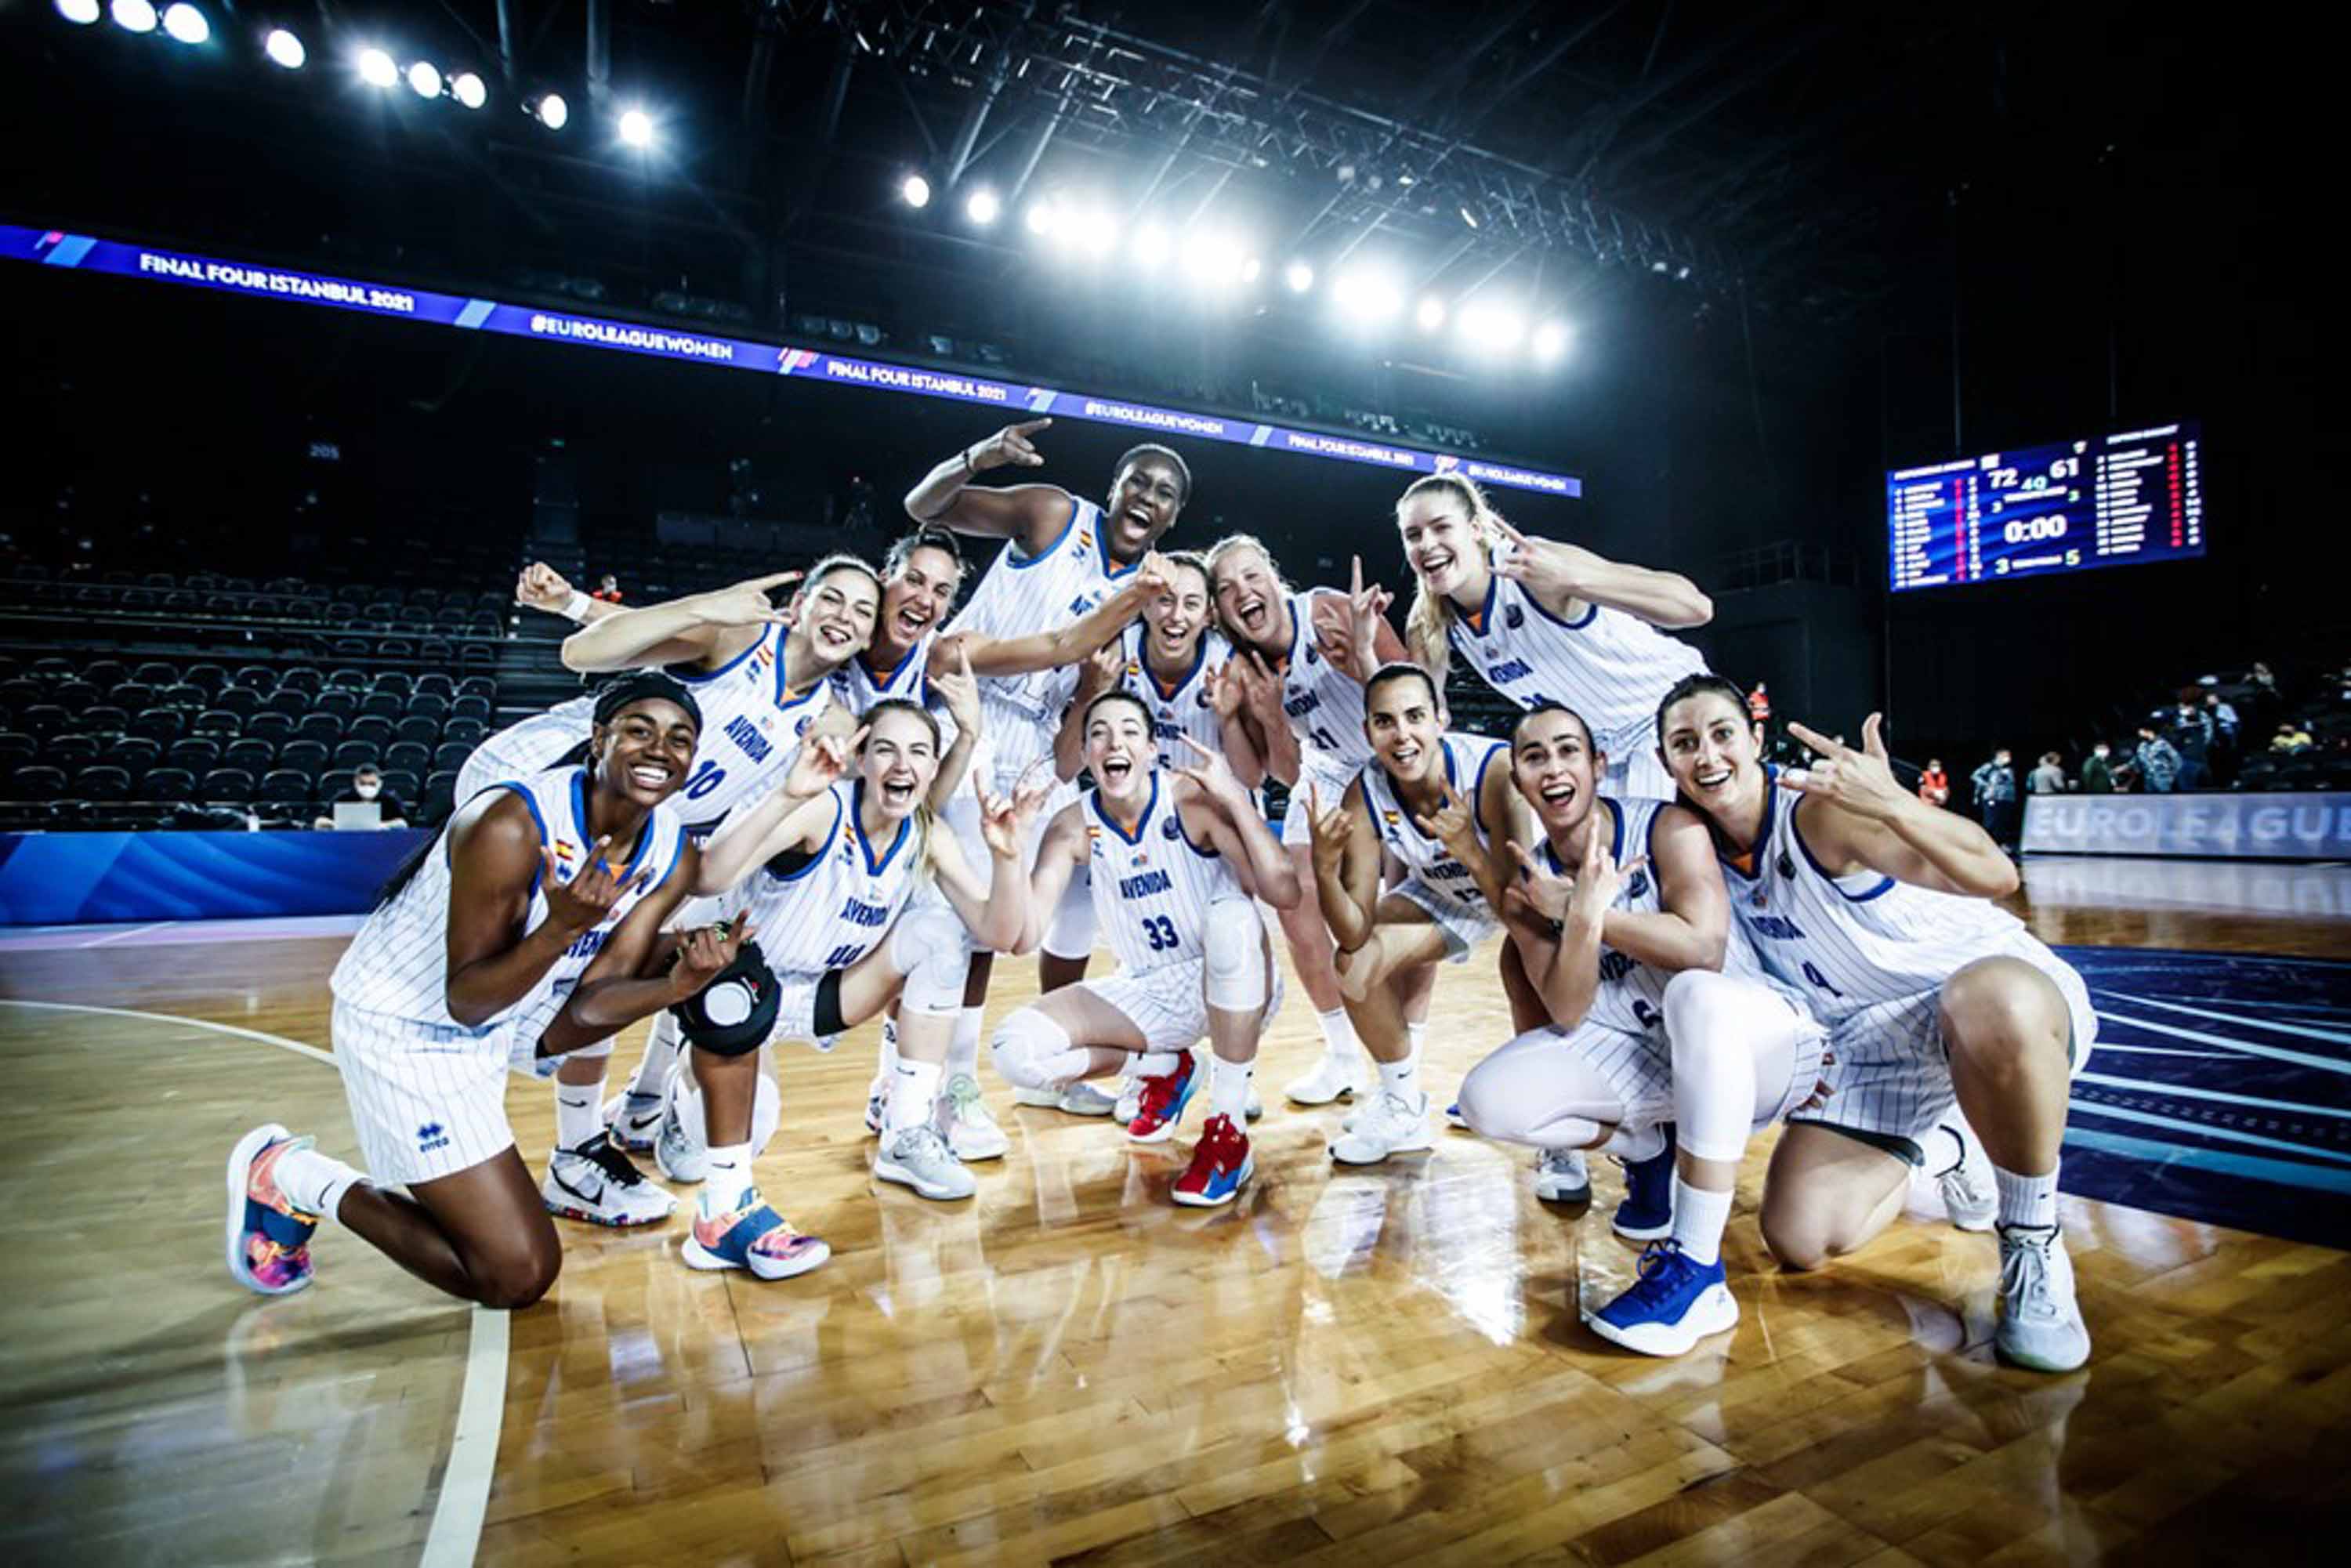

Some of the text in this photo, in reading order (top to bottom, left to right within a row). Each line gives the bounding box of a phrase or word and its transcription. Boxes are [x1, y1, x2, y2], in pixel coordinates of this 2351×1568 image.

[140, 252, 415, 312] FINAL FOUR ISTANBUL 2021
[531, 313, 734, 359] #EUROLEAGUEWOMEN
[828, 360, 870, 380] FINAL
[871, 366, 910, 386] FOUR
[911, 372, 976, 397] ISTANBUL
[1085, 400, 1224, 433] #EUROLEAGUEWOMEN
[1988, 467, 2019, 489] 72
[2048, 457, 2079, 479] 61
[2004, 514, 2067, 544] 0:00
[1994, 557, 2009, 574] 3
[2065, 549, 2080, 566] 5
[723, 714, 773, 765] AVENIDA
[679, 759, 726, 799] 10
[1119, 869, 1172, 899] AVENIDA
[1142, 914, 1180, 953] 33
